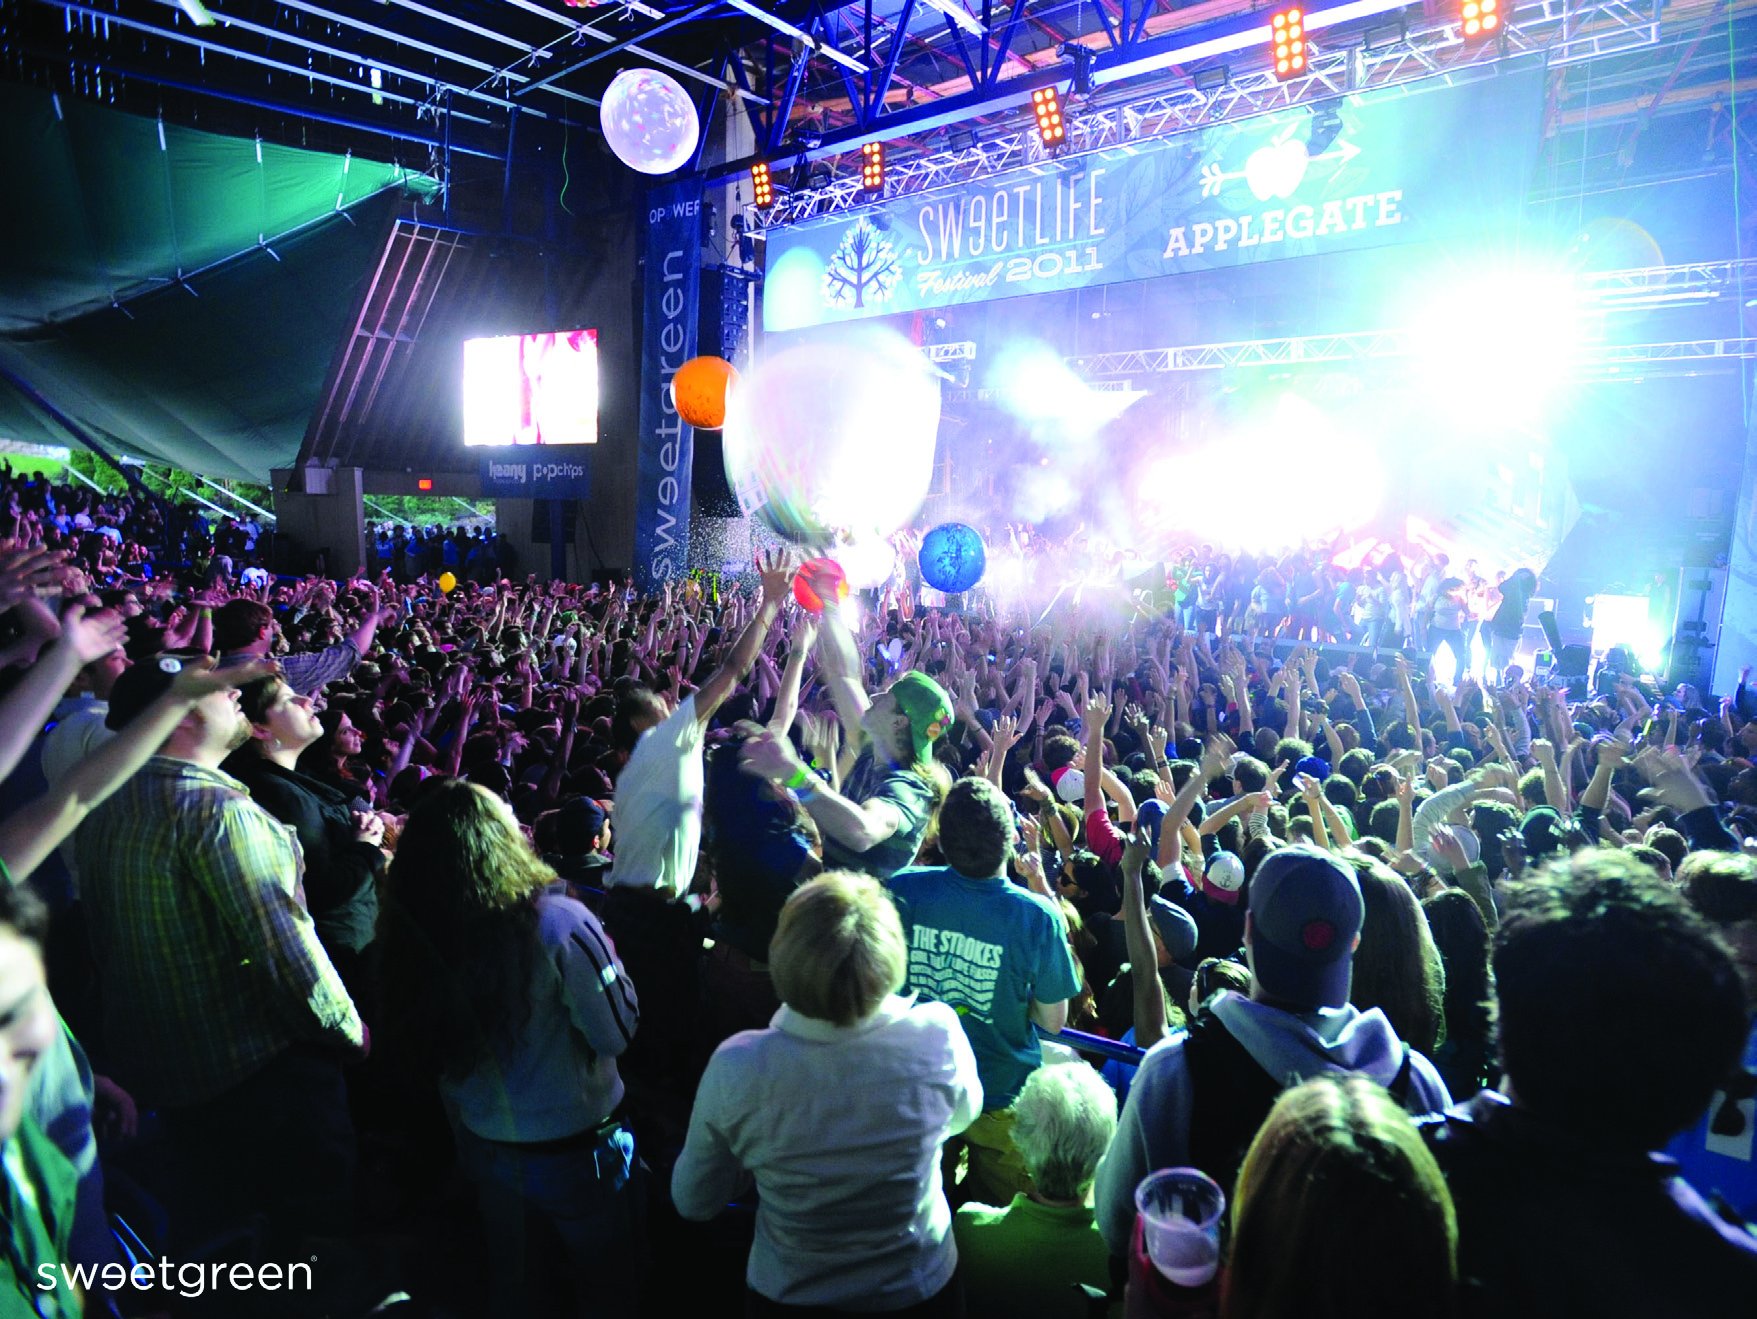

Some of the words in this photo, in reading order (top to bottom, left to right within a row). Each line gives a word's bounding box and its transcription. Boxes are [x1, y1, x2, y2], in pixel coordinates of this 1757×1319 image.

[649, 199, 700, 224] OPWER
[1163, 190, 1402, 259] APPLEGATE
[916, 261, 1004, 298] Festival
[1005, 247, 1104, 282] 2011
[912, 924, 939, 953] THE
[939, 930, 1003, 968] STROKES
